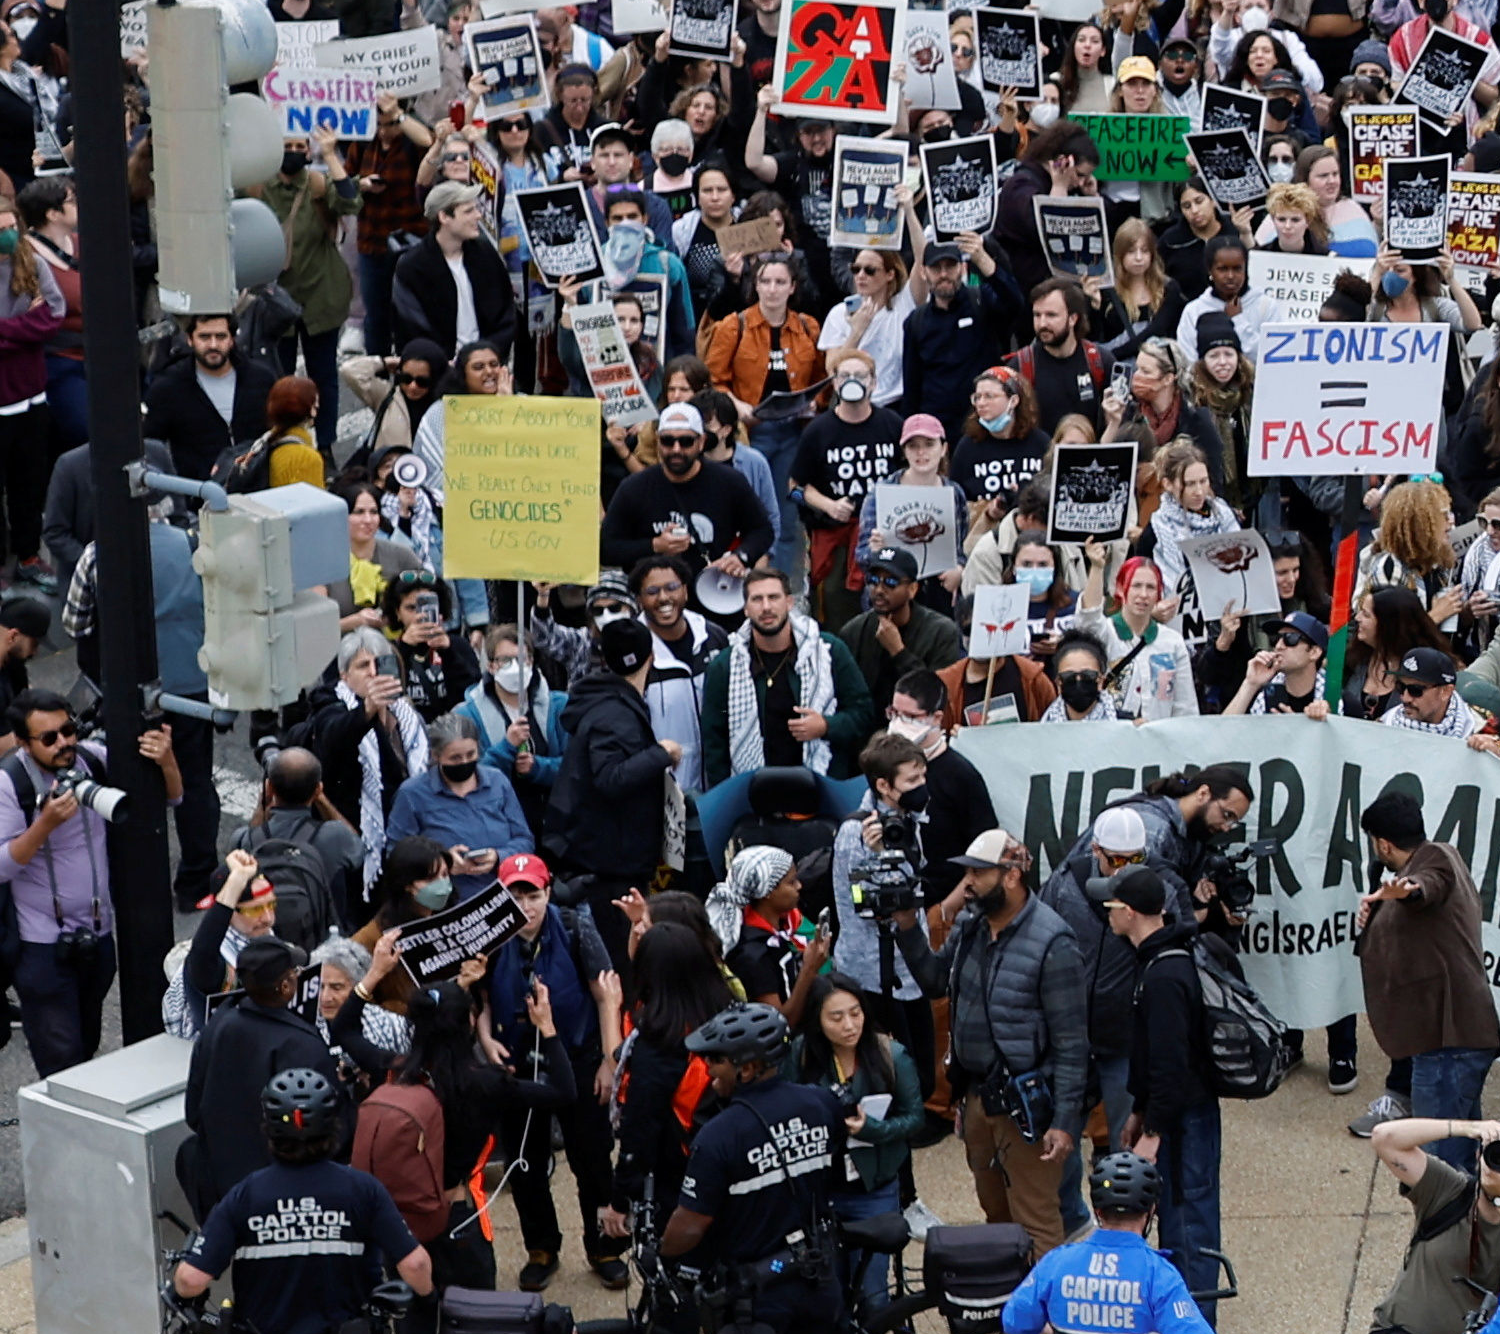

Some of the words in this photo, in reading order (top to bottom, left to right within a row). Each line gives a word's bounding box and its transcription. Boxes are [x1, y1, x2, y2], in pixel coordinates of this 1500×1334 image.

[266, 71, 375, 101] CEASEFIRE
[287, 106, 370, 135] NOW
[1263, 328, 1443, 365] ZIONISM
[1261, 420, 1433, 460] FASCISM
[277, 1197, 321, 1213] U.S.
[248, 1210, 351, 1231] CAPITOL
[257, 1226, 342, 1243] POLICE
